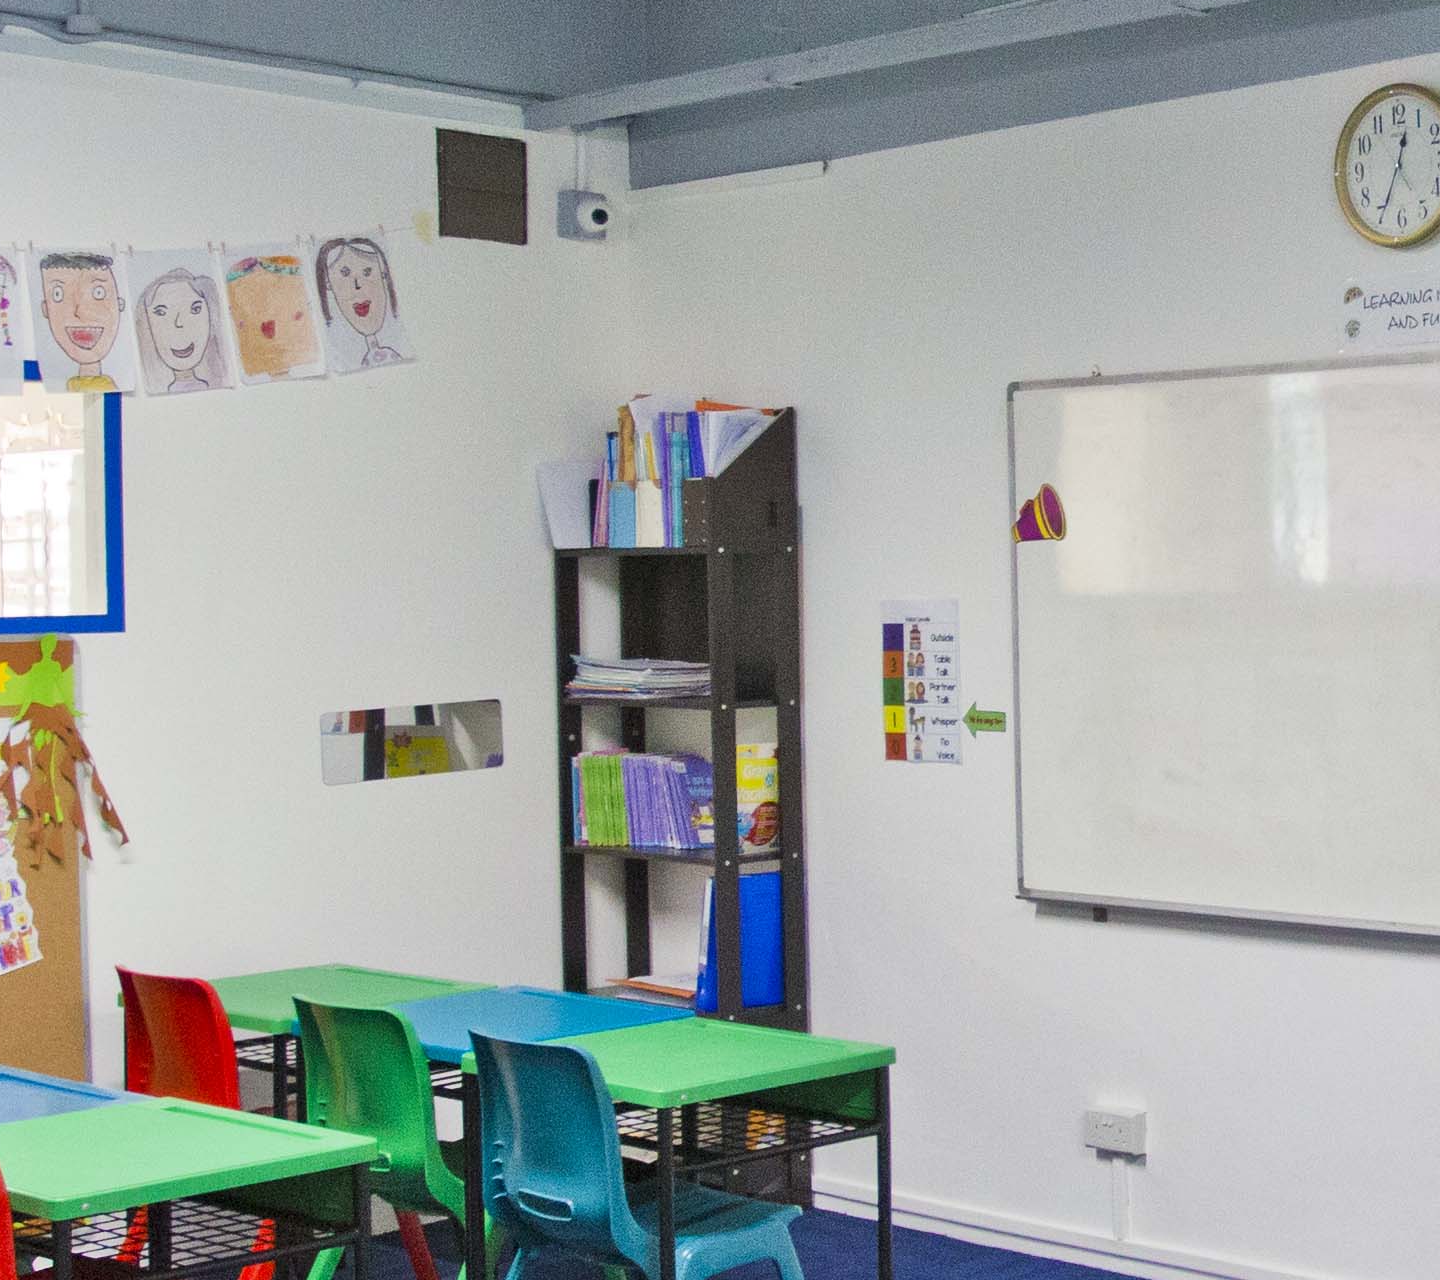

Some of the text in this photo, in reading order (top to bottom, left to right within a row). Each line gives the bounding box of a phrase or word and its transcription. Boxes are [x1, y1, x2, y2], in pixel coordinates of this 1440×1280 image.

[1373, 115, 1383, 134] 11
[1392, 104, 1405, 125] 12
[1416, 108, 1421, 128] 1
[1429, 123, 1440, 144] 2
[1358, 134, 1371, 156] 10
[1354, 161, 1364, 183] 9
[1430, 177, 1440, 196] 4
[1361, 187, 1370, 208] 8
[1377, 204, 1387, 224] 7
[1397, 208, 1407, 228] 6
[1418, 200, 1428, 219] 5
[1363, 289, 1432, 309] LEARNING
[1388, 315, 1418, 330] AND
[930, 634, 954, 642] Outside
